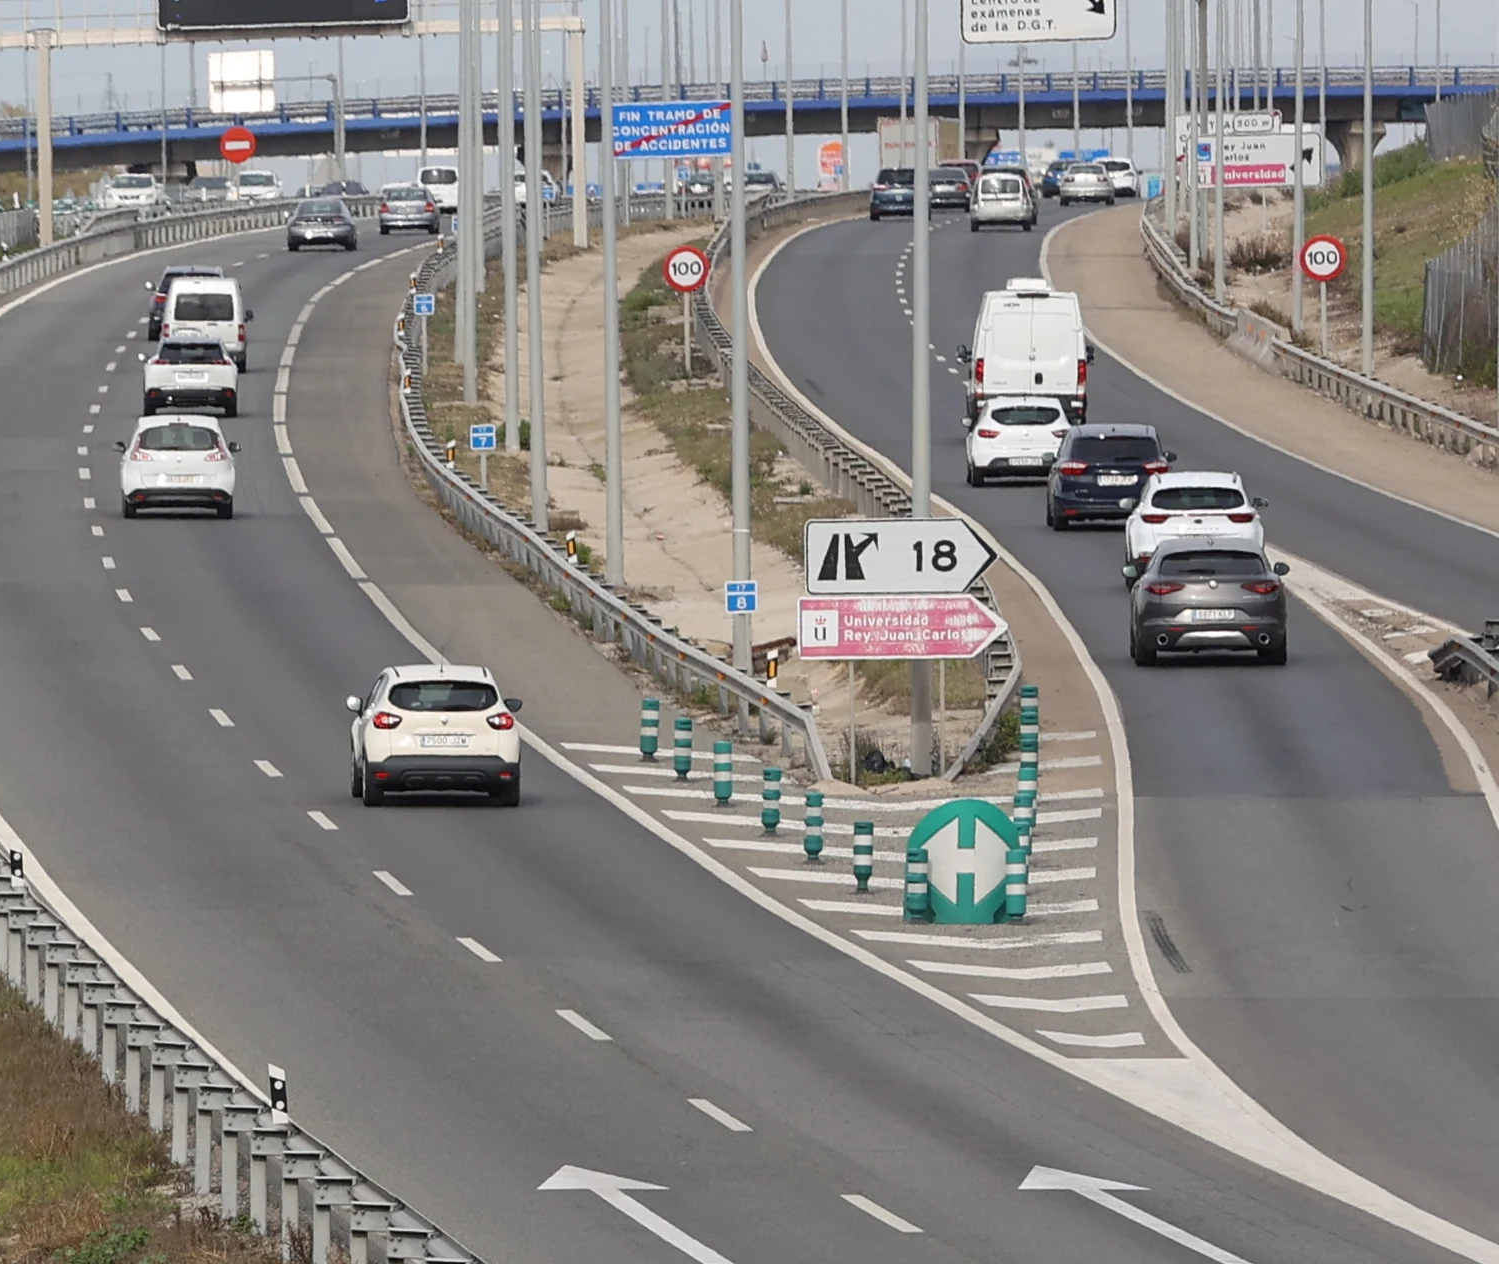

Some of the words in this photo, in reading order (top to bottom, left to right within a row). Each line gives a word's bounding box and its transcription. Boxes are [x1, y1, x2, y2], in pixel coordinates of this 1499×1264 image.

[971, 8, 1040, 19] exámenes
[971, 21, 987, 32] de
[995, 21, 1008, 32] la
[1017, 19, 1057, 31] D.G.T.
[619, 111, 640, 121] FIN
[648, 109, 696, 121] TRAMO
[703, 108, 721, 119] DE
[612, 121, 731, 137] CONCENTRACIÓN
[1237, 118, 1259, 128] 500
[614, 140, 632, 152] DE
[640, 137, 727, 151] ACCIDENTES
[1241, 141, 1266, 150] Juan
[1223, 153, 1249, 162] arlos
[1224, 168, 1285, 181] niversidad
[1308, 250, 1338, 266] 100
[671, 261, 702, 276] 100
[478, 436, 487, 447] 7
[913, 540, 958, 572] 18
[736, 597, 747, 609] 8
[844, 614, 929, 626] Universidad
[922, 629, 968, 641] Carlos
